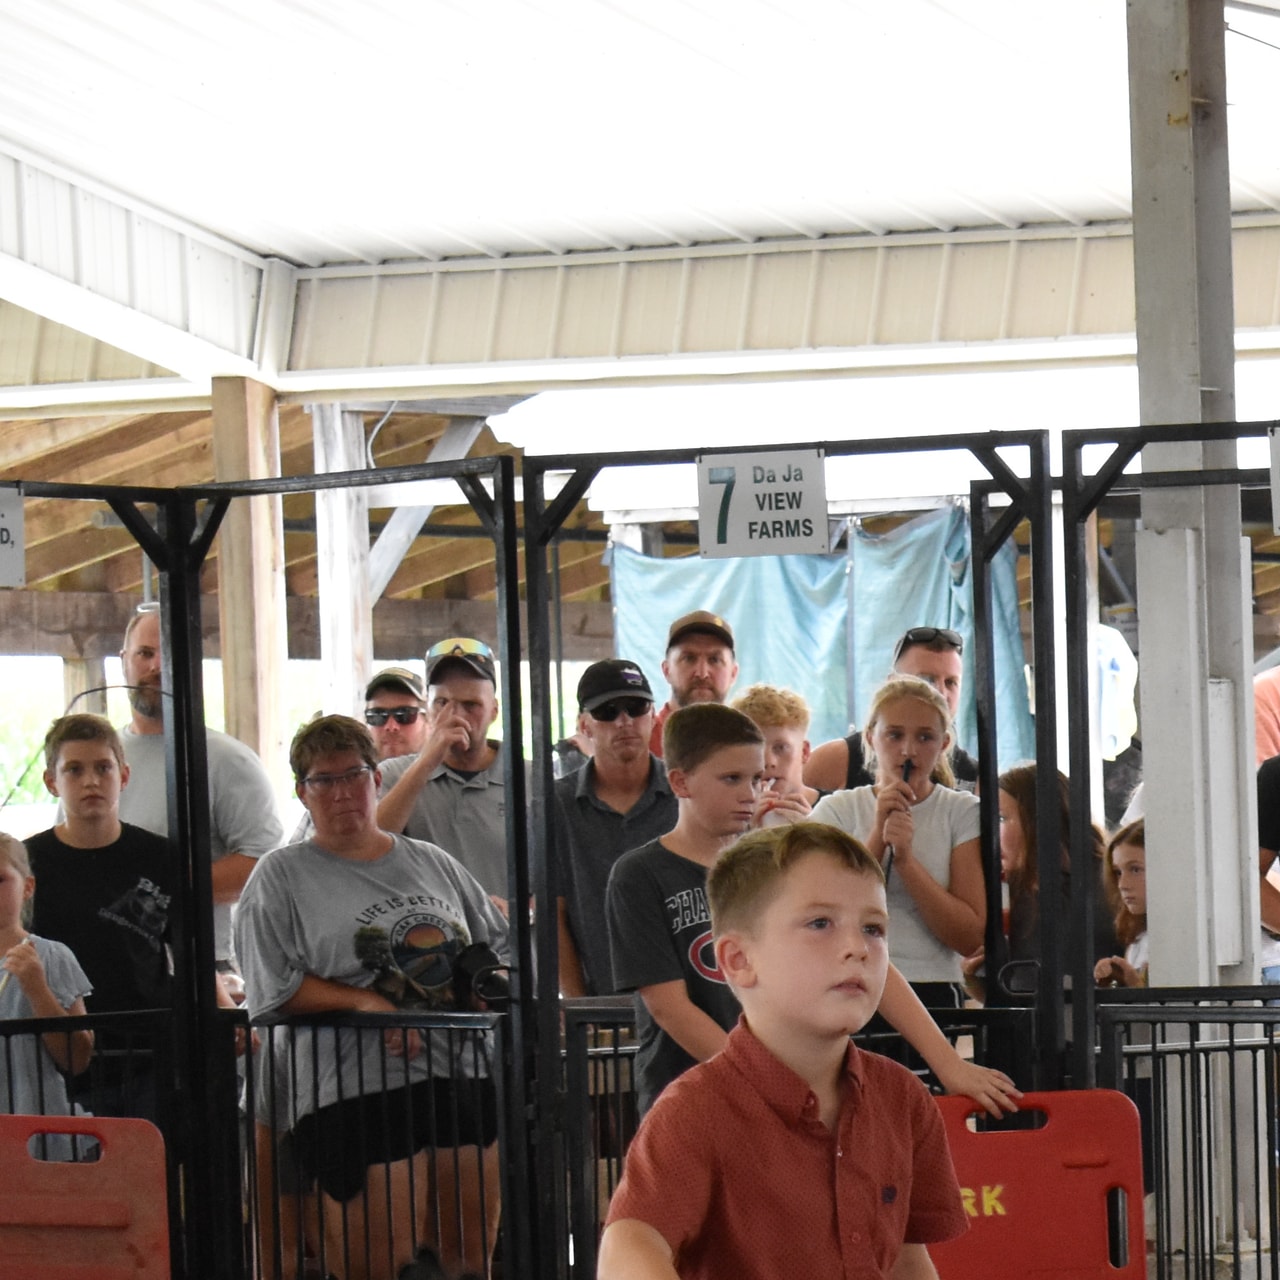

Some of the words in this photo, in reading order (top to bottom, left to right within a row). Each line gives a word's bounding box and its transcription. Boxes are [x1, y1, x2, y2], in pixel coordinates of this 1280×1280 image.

[752, 464, 777, 484] Da
[781, 463, 804, 483] Ja
[708, 466, 737, 545] 7
[754, 490, 803, 512] VIEW
[747, 518, 814, 540] FARMS
[355, 903, 387, 926] LIFE
[385, 897, 405, 910] IS
